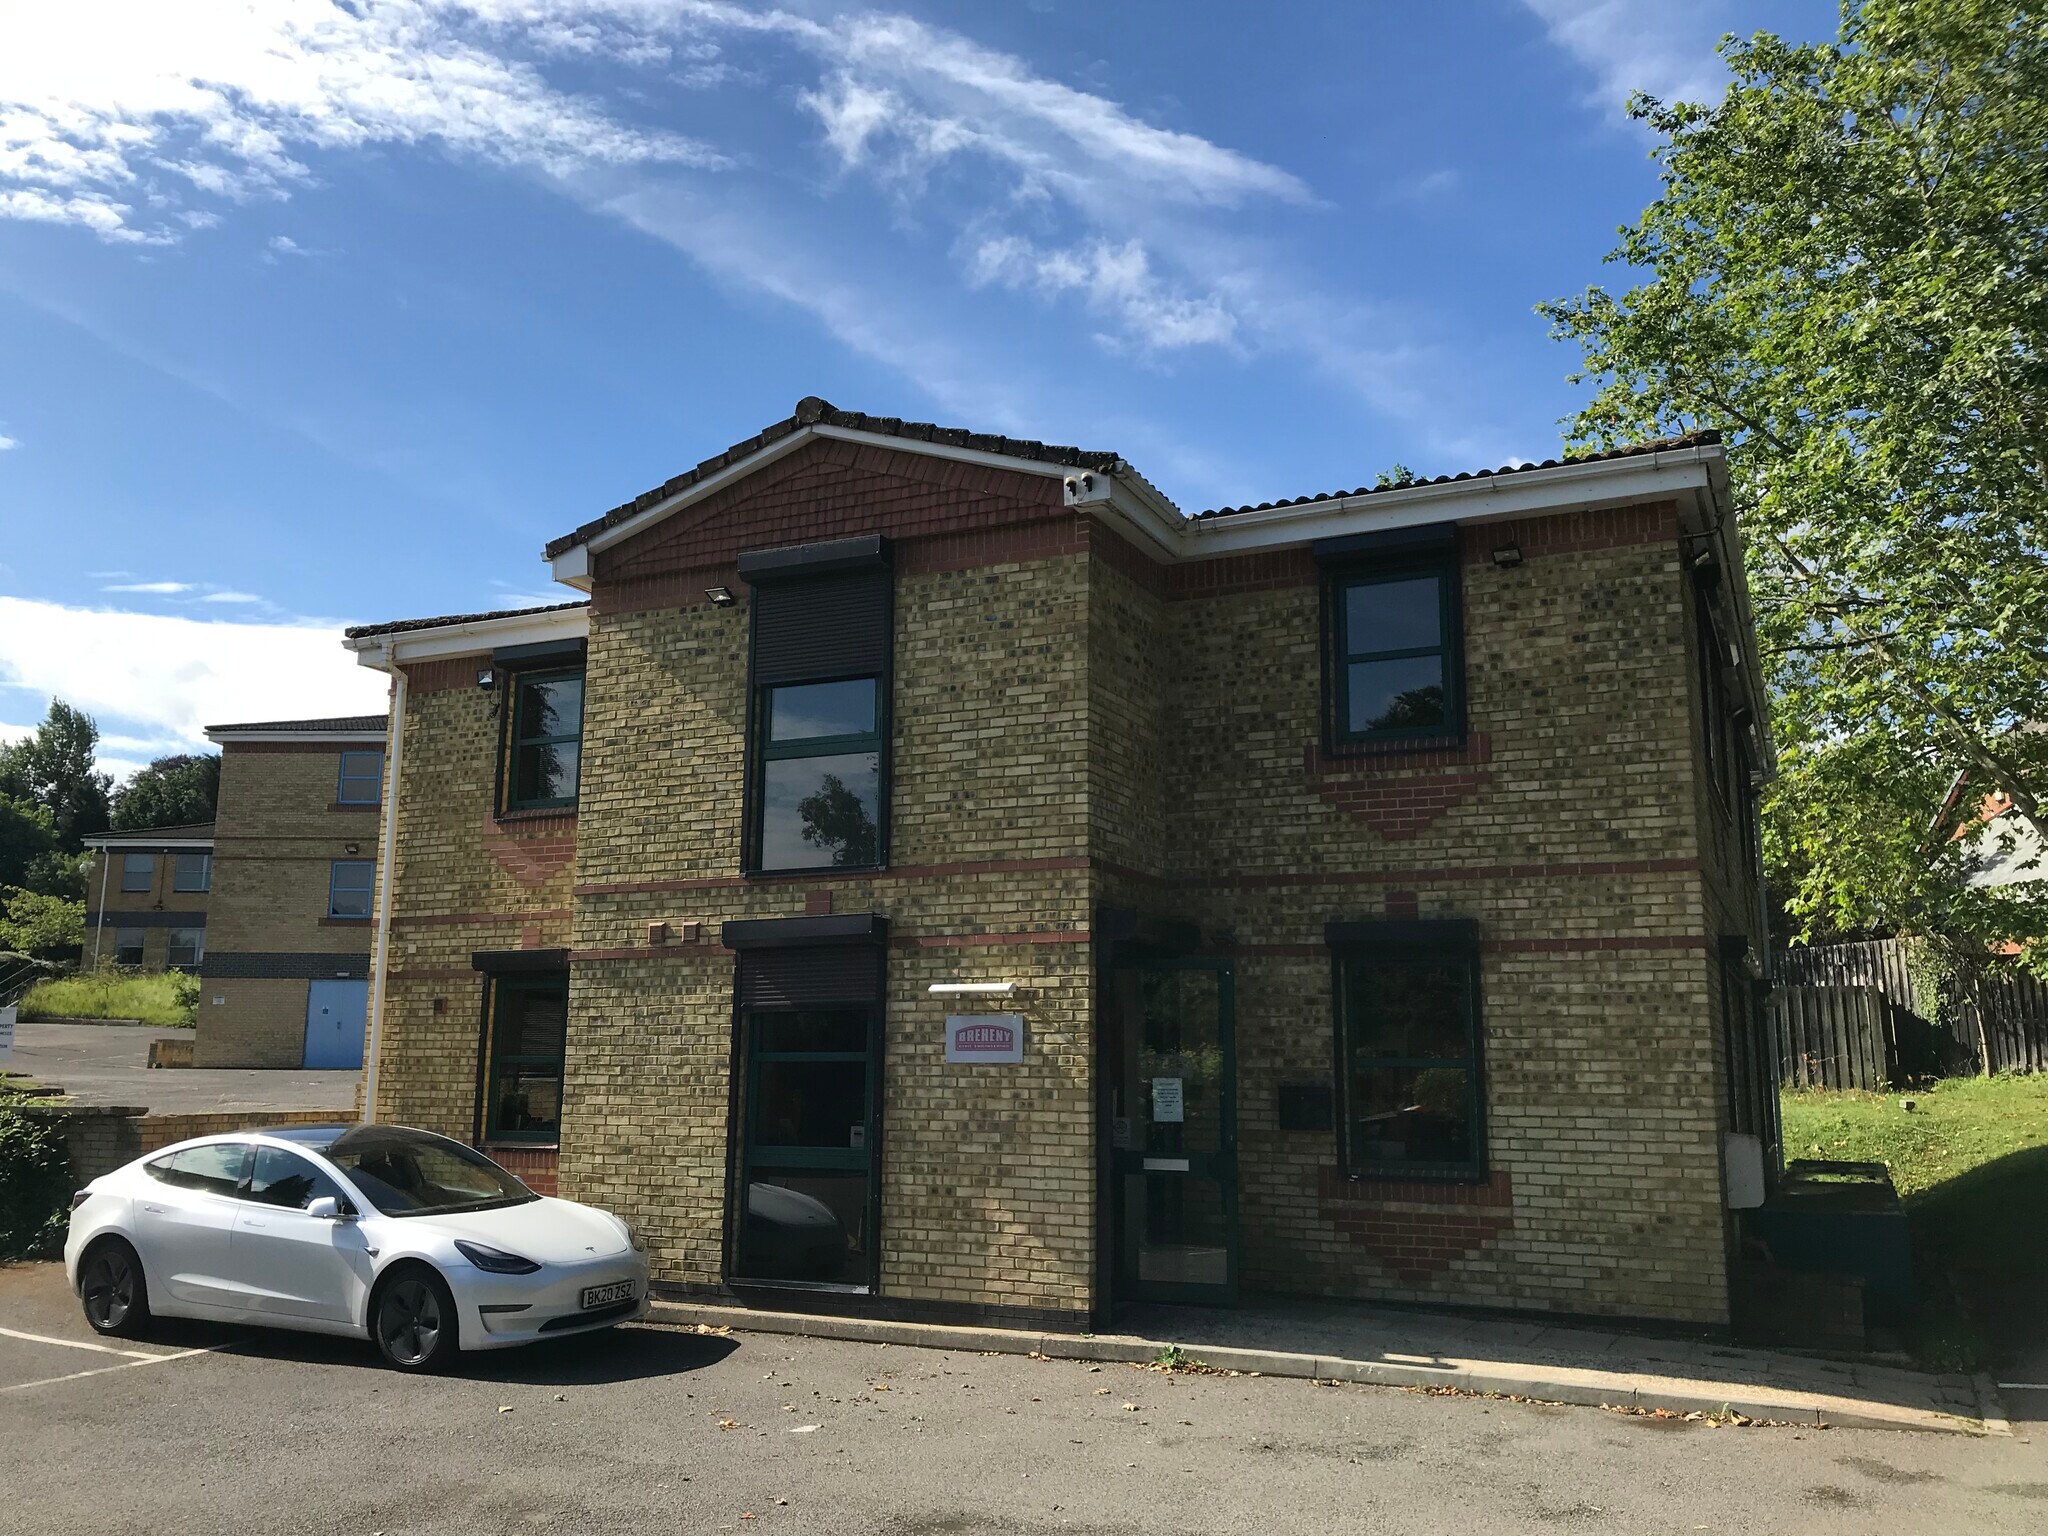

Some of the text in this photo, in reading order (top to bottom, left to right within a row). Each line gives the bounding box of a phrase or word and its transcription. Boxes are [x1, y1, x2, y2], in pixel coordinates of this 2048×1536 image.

[958, 1028, 1011, 1042] BREHENY
[587, 1283, 632, 1305] BK20 ZSZ
